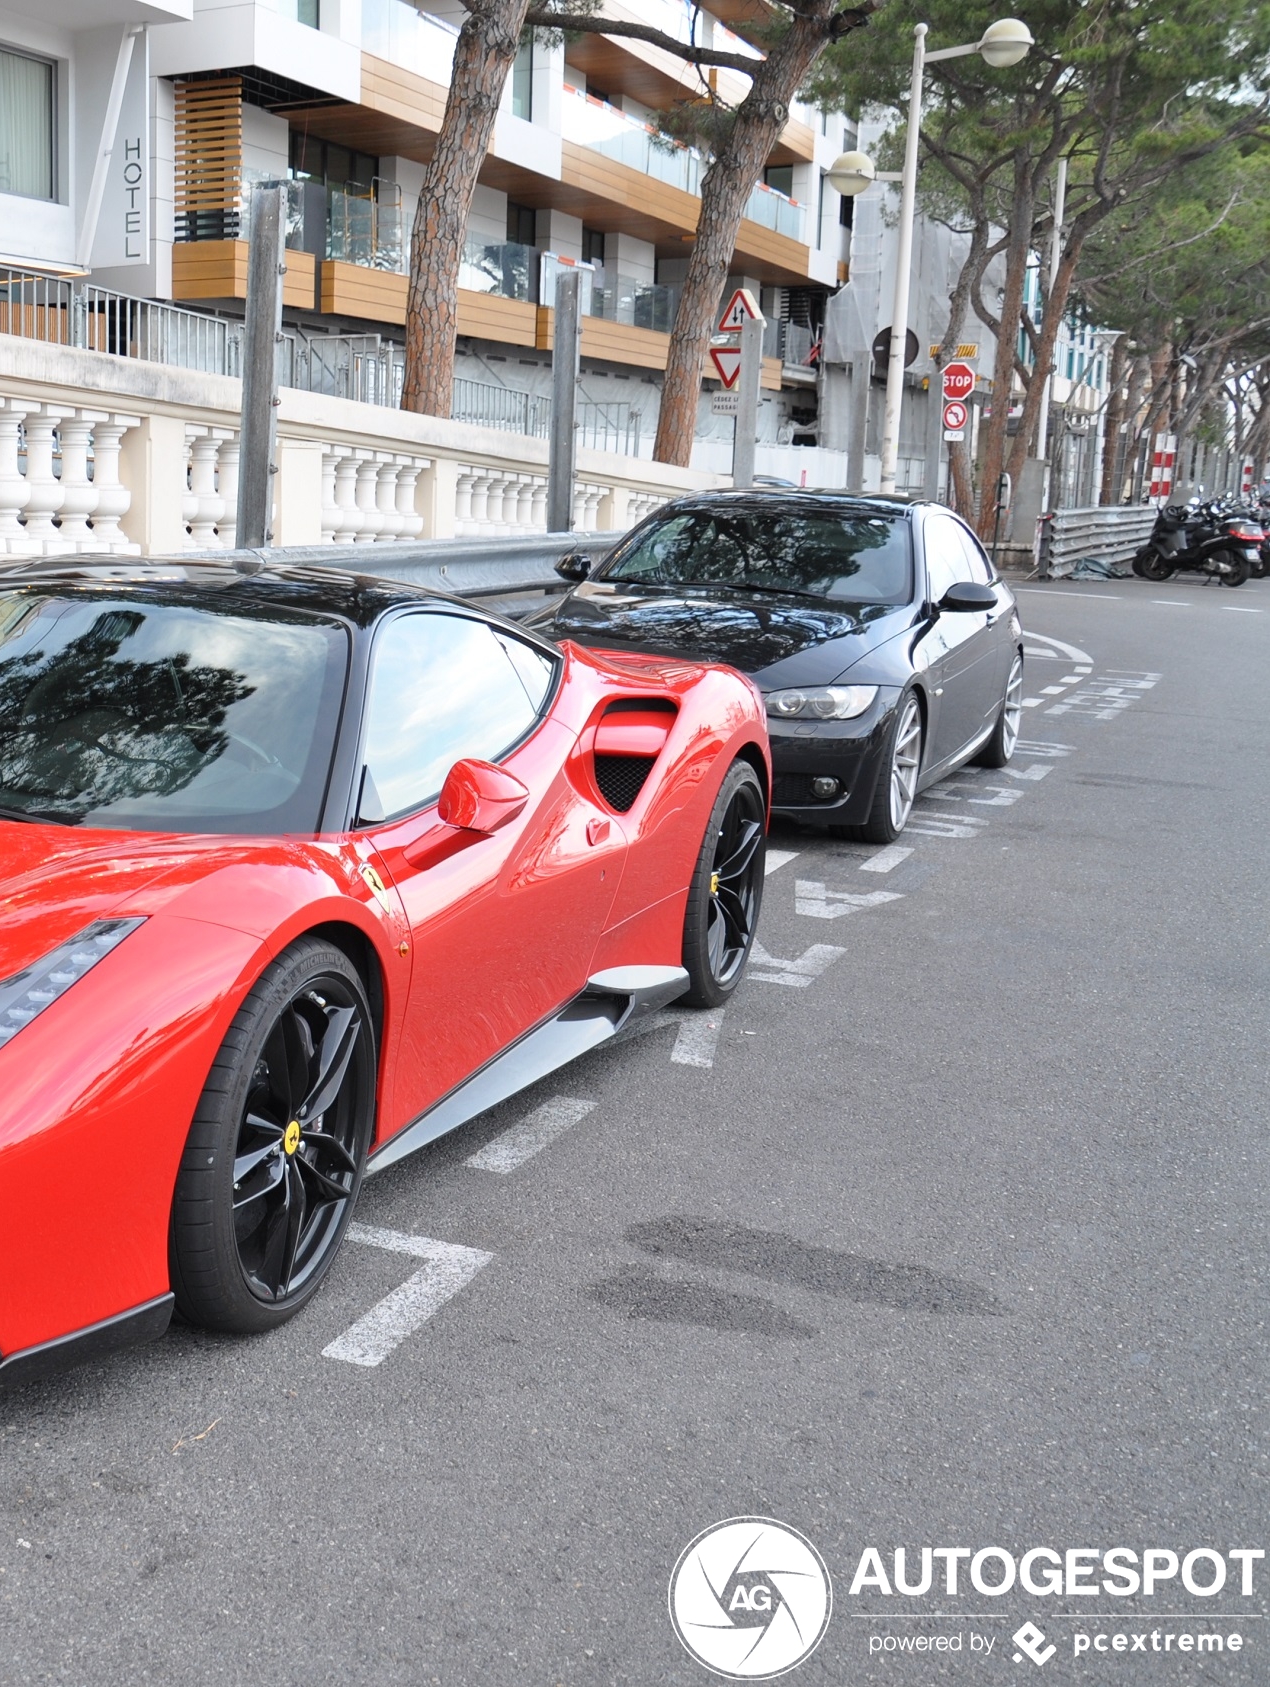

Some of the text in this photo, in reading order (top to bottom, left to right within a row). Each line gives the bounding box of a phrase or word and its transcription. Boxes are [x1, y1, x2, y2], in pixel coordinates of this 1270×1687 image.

[124, 138, 142, 258] HOTEL
[942, 375, 972, 388] STOP
[299, 952, 335, 973] MICHELIN
